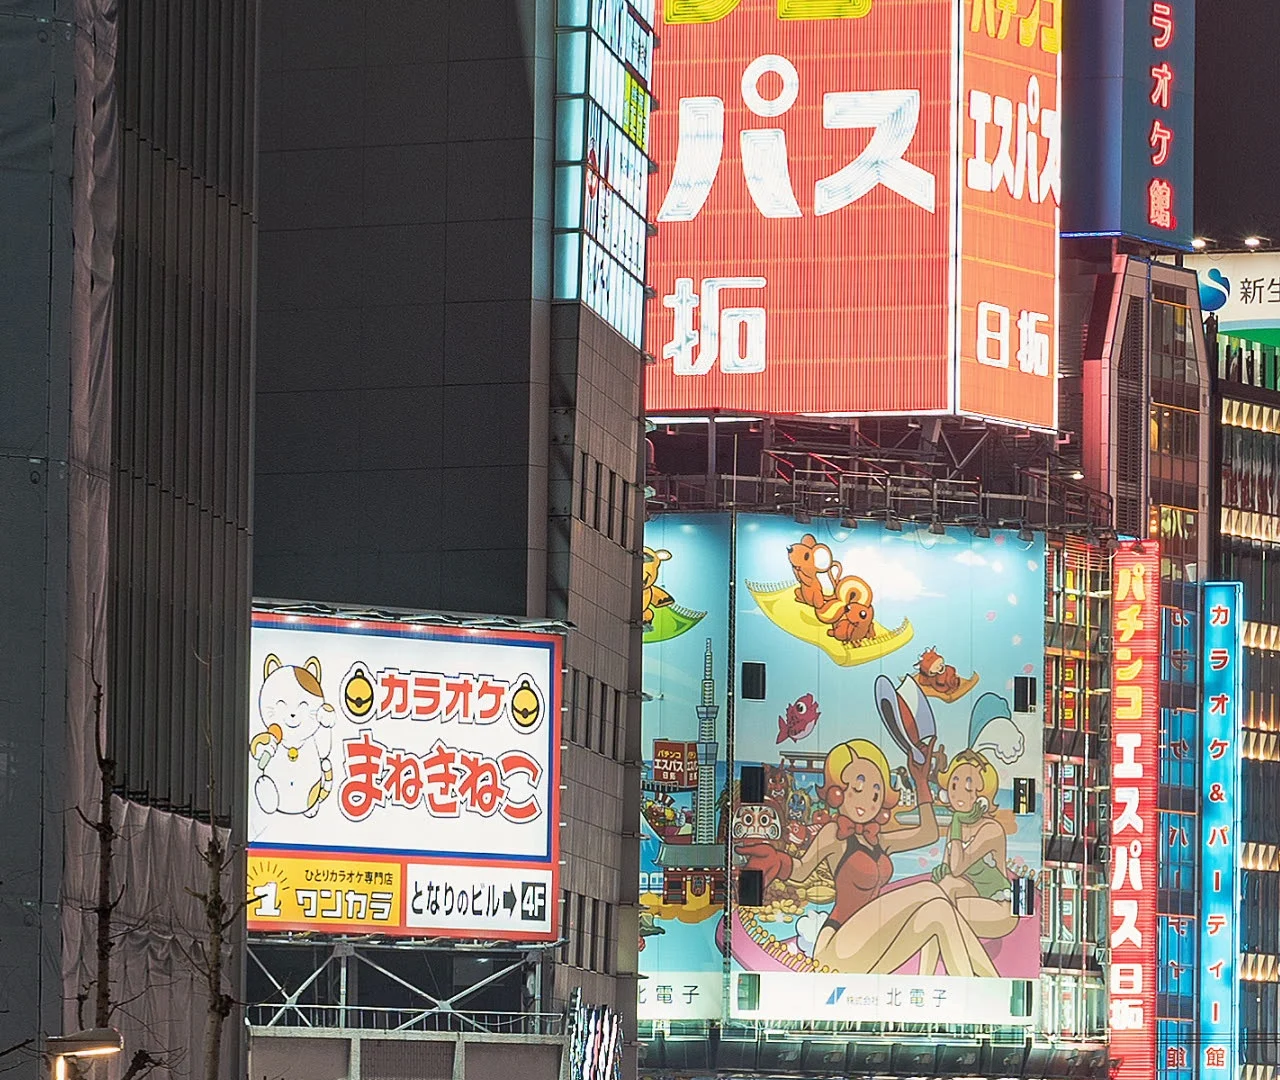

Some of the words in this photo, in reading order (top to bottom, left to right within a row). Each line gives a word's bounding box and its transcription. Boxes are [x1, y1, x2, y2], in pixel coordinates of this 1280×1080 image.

[976, 301, 1050, 376] 日拓
[381, 672, 506, 722] カラオケ
[341, 733, 544, 818] まねきねこ
[304, 867, 394, 886] ひとりカラオケ専門店
[294, 888, 394, 921] ワンカラ
[411, 882, 500, 918] となりのビル
[523, 884, 547, 918] 4F
[885, 986, 949, 1009] 北電子
